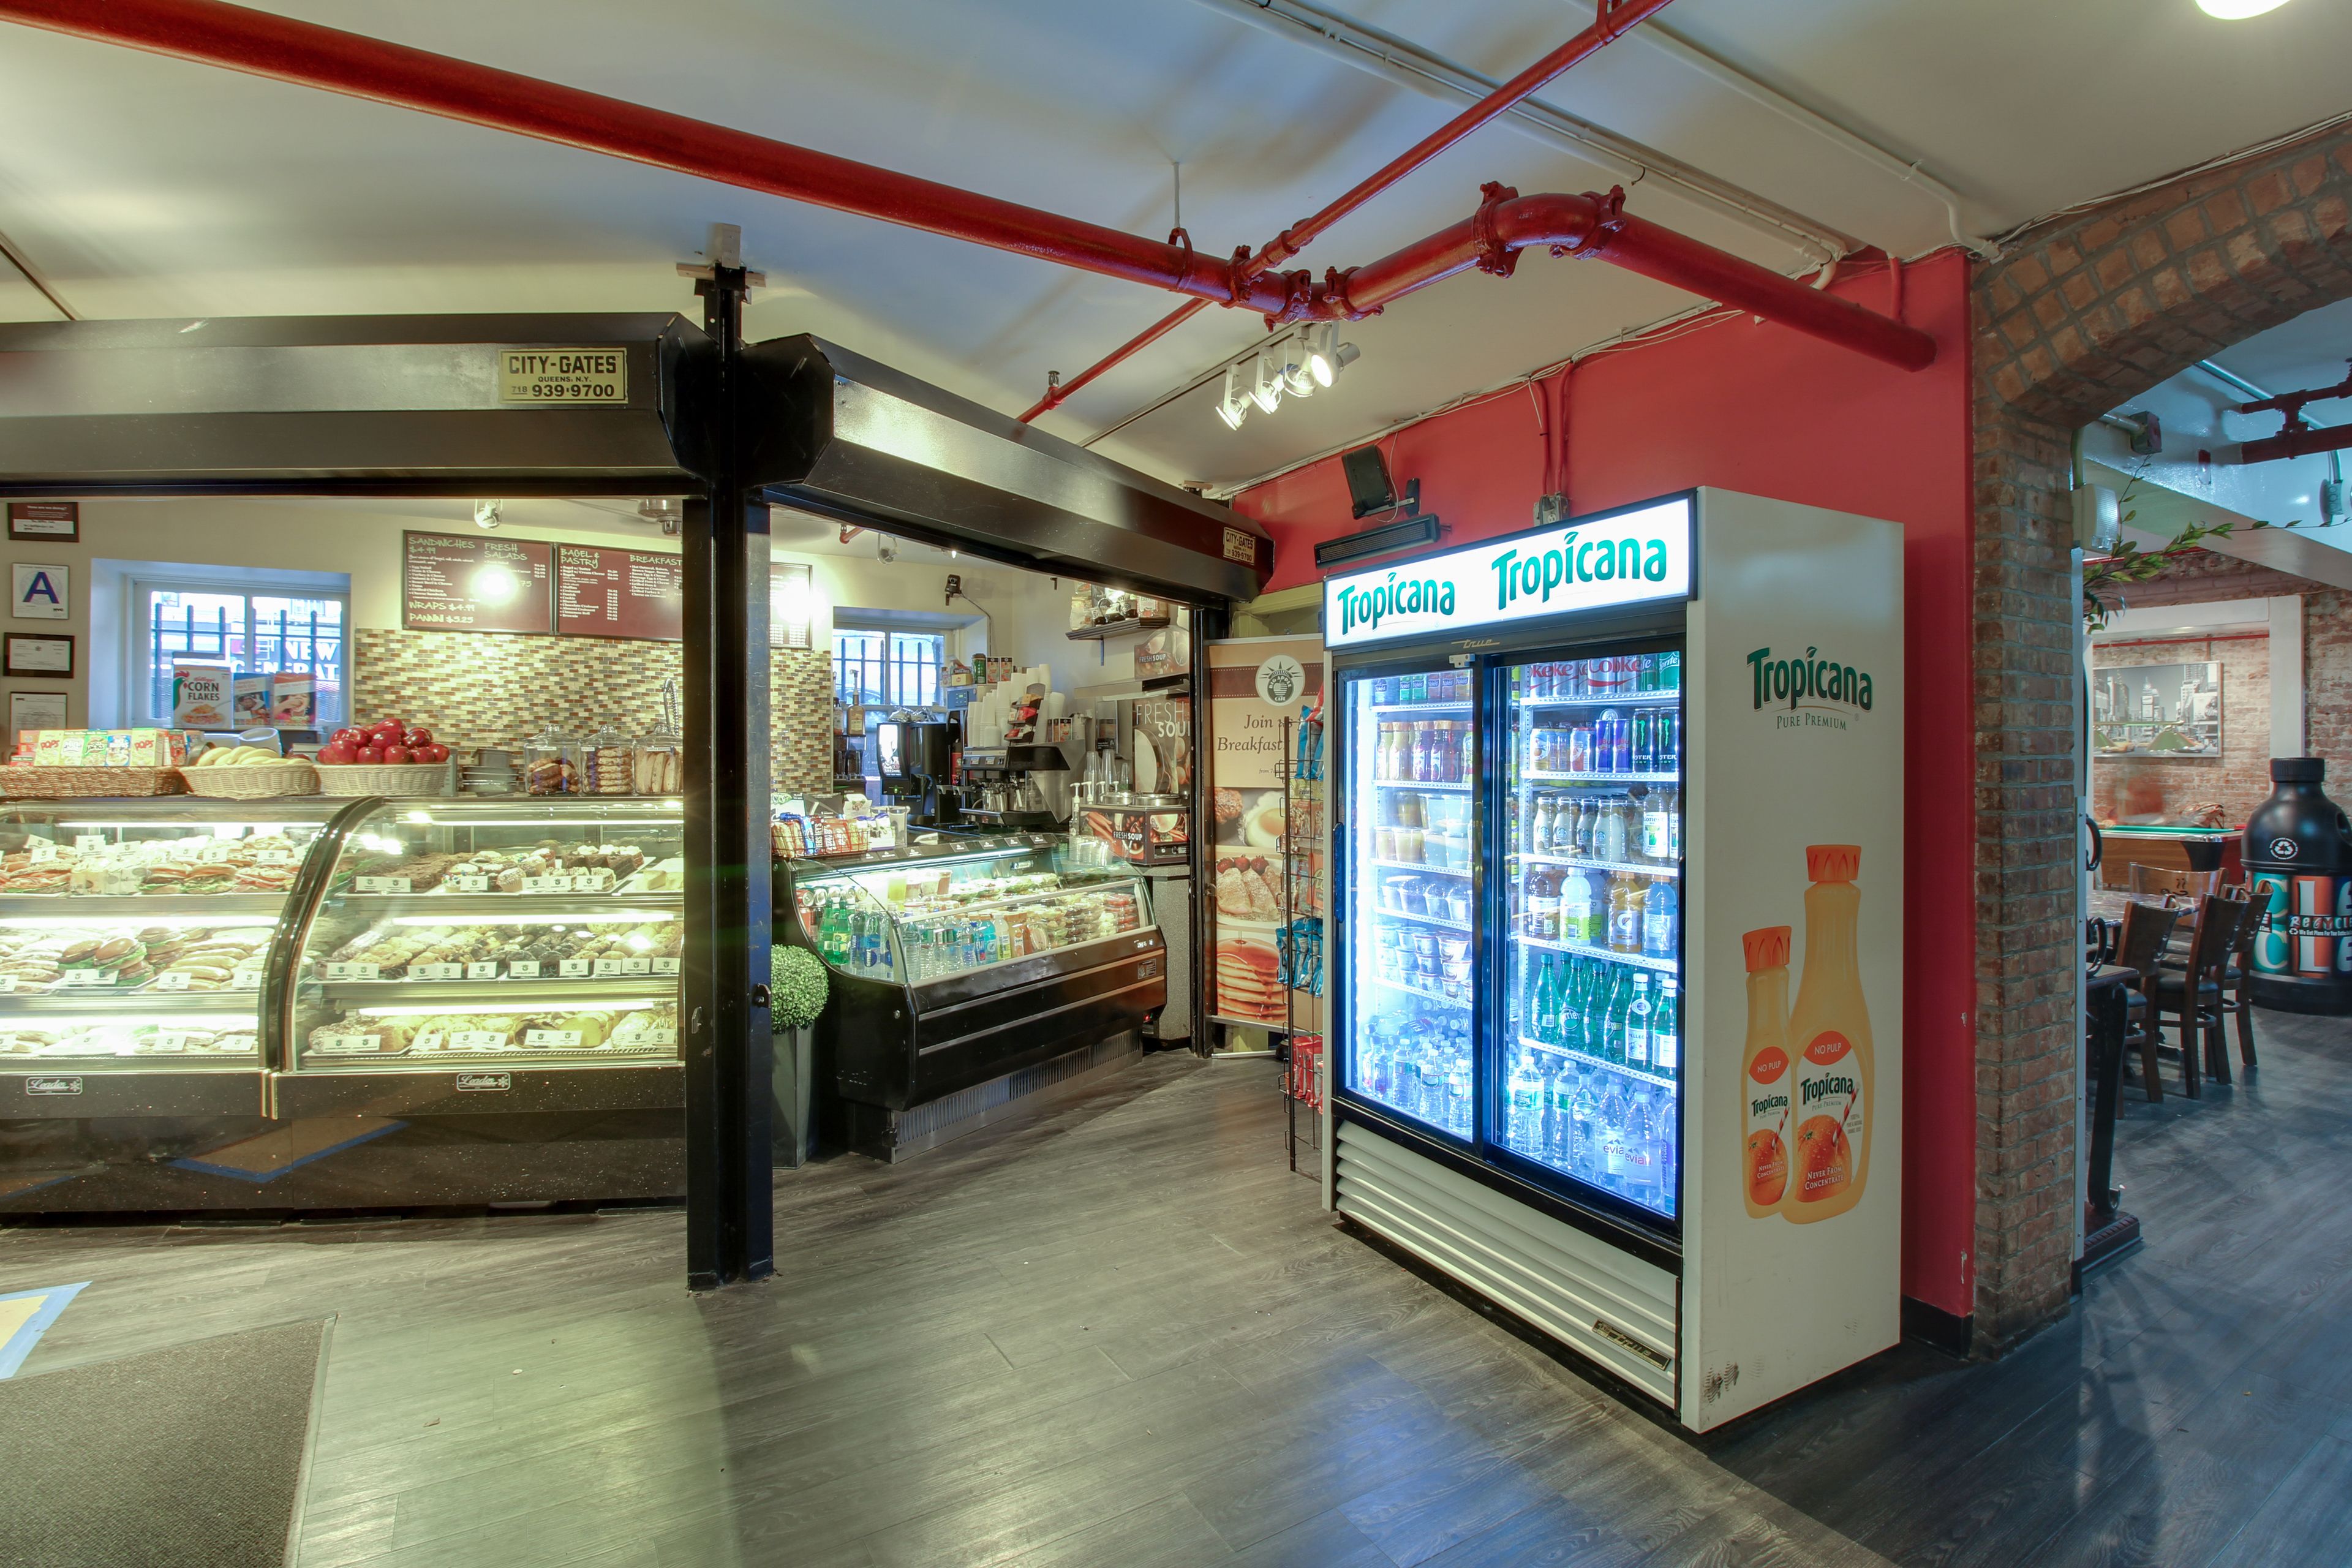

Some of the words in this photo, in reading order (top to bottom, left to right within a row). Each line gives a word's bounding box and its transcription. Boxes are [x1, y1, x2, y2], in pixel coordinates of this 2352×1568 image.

[409, 537, 476, 549] SANDWICHES
[484, 543, 518, 553] FRESH
[484, 551, 528, 560] SALADS
[560, 548, 593, 558] BAGEL
[630, 554, 682, 566] BREAKFAST
[1491, 532, 1667, 611] Tropicana
[23, 571, 59, 604] A
[409, 600, 447, 610] WRAPS
[448, 603, 475, 611] $4.99
[1337, 571, 1455, 636] Tropicana
[285, 641, 337, 661] NEW
[1277, 676, 1292, 688] APPLE
[1747, 646, 1872, 712] Tropicana
[188, 681, 220, 692] CORN
[188, 693, 220, 701] FLAKES
[1136, 701, 1184, 725] FRESH
[1244, 714, 1273, 729] Join
[1777, 715, 1801, 729] PURE
[1805, 712, 1847, 731] PREMIUM
[40, 739, 60, 750] POPS
[134, 740, 154, 750] POPS
[1217, 736, 1283, 754] Breakfast
[1814, 1045, 1825, 1055] NO
[1826, 1042, 1841, 1052] PULP
[1768, 1060, 1781, 1069] PULP
[1801, 1072, 1853, 1105] Tropicana
[1751, 1094, 1787, 1117] Tropicana
[1807, 1169, 1826, 1180] NEVER
[1826, 1166, 1842, 1176] FROM
[1804, 1174, 1844, 1190] CONCENTRATE
